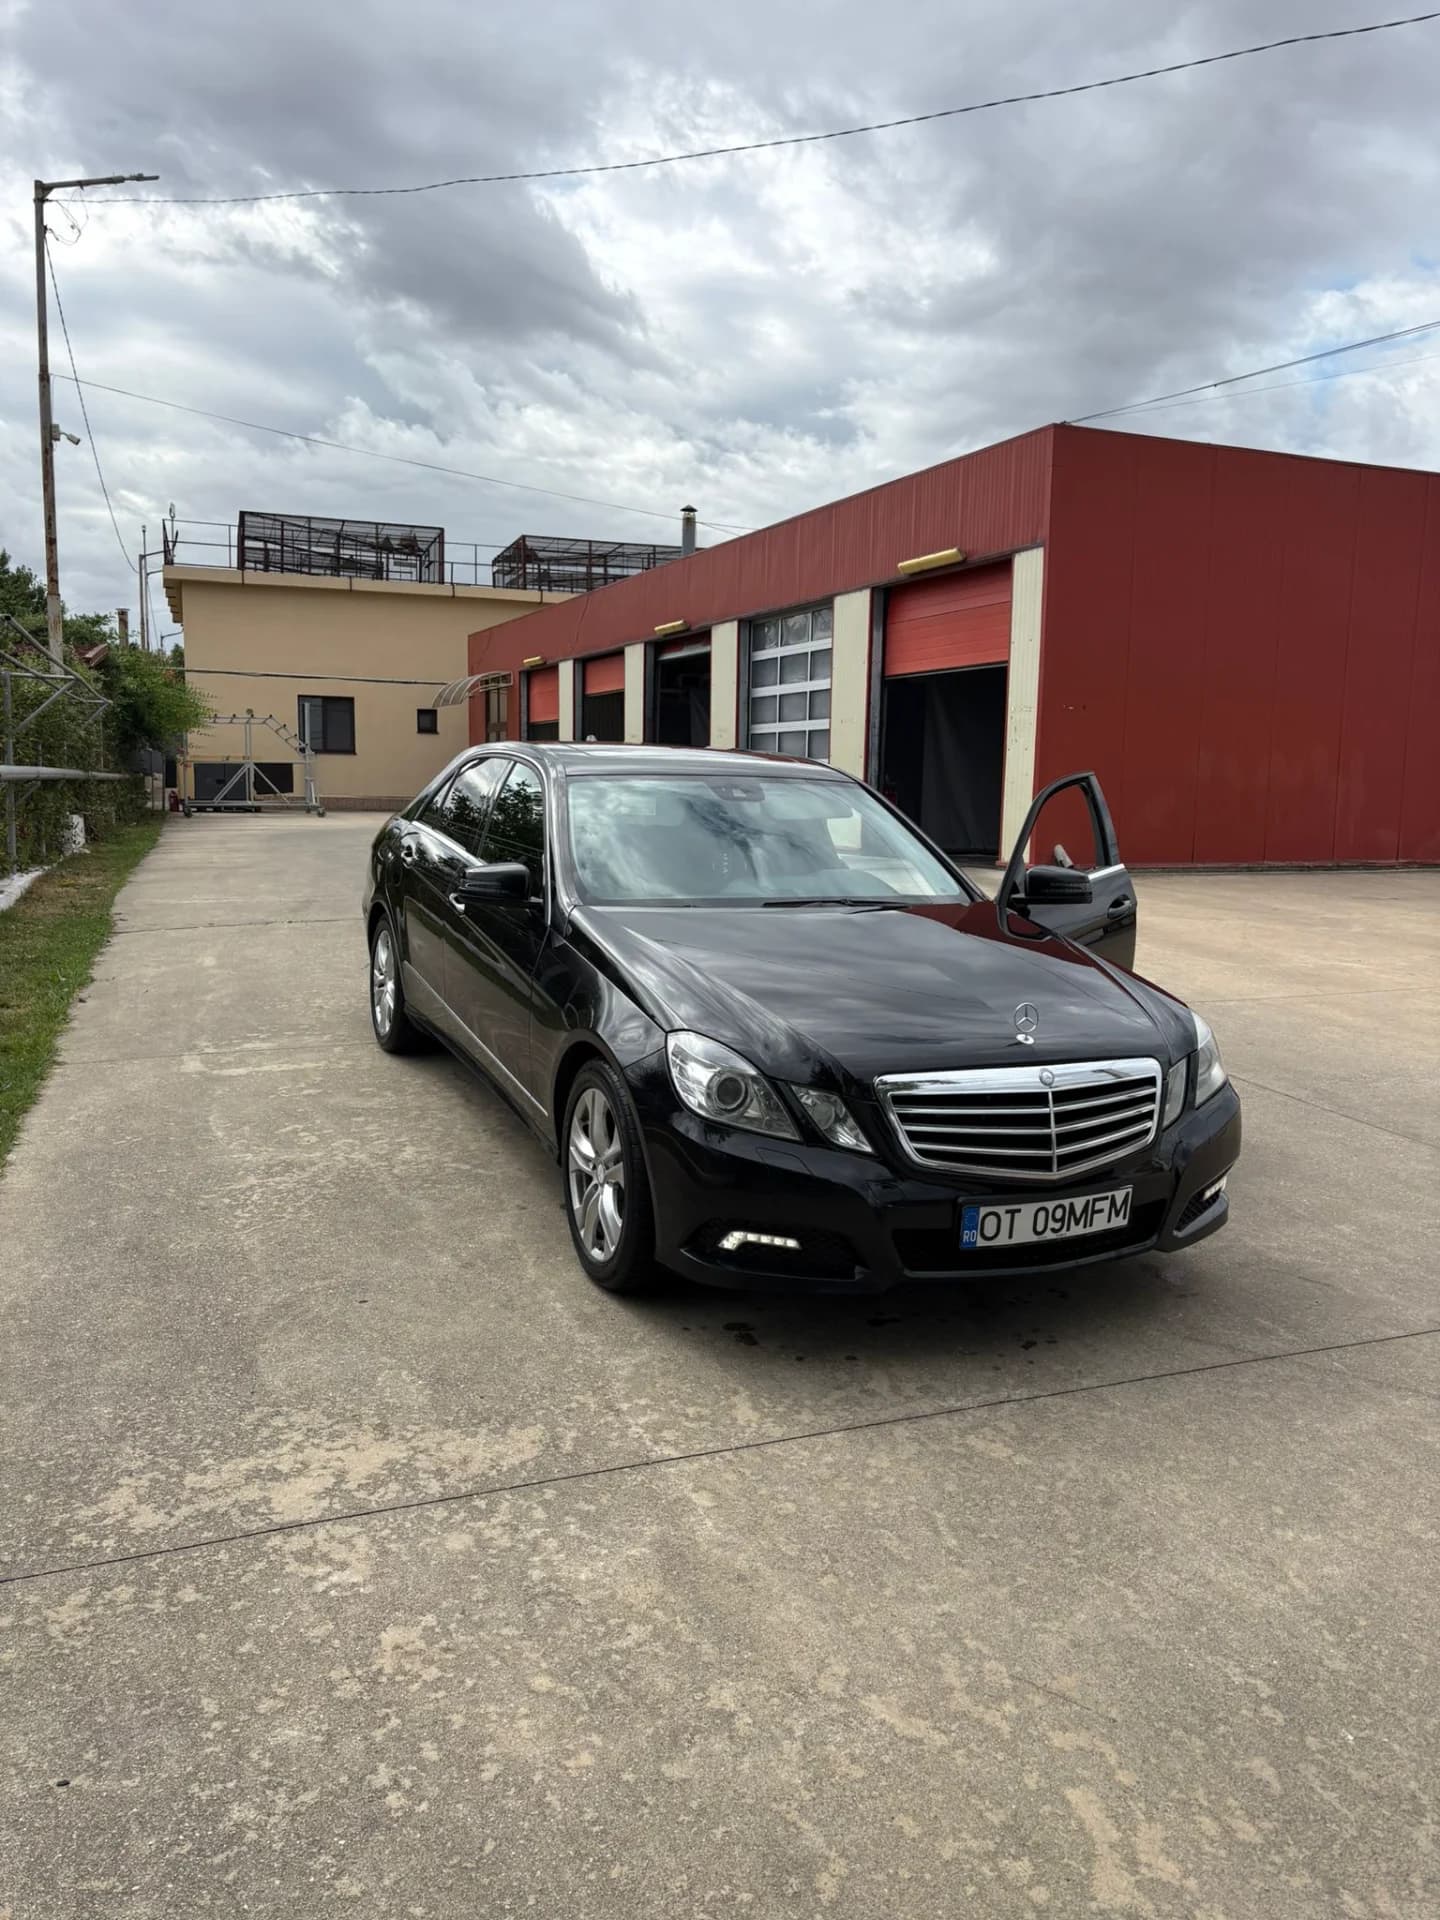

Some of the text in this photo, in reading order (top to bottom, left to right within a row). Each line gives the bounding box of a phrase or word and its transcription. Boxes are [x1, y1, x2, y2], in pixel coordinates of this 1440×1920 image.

[979, 1191, 1130, 1242] OT 09MFM
[963, 1230, 977, 1243] RO
